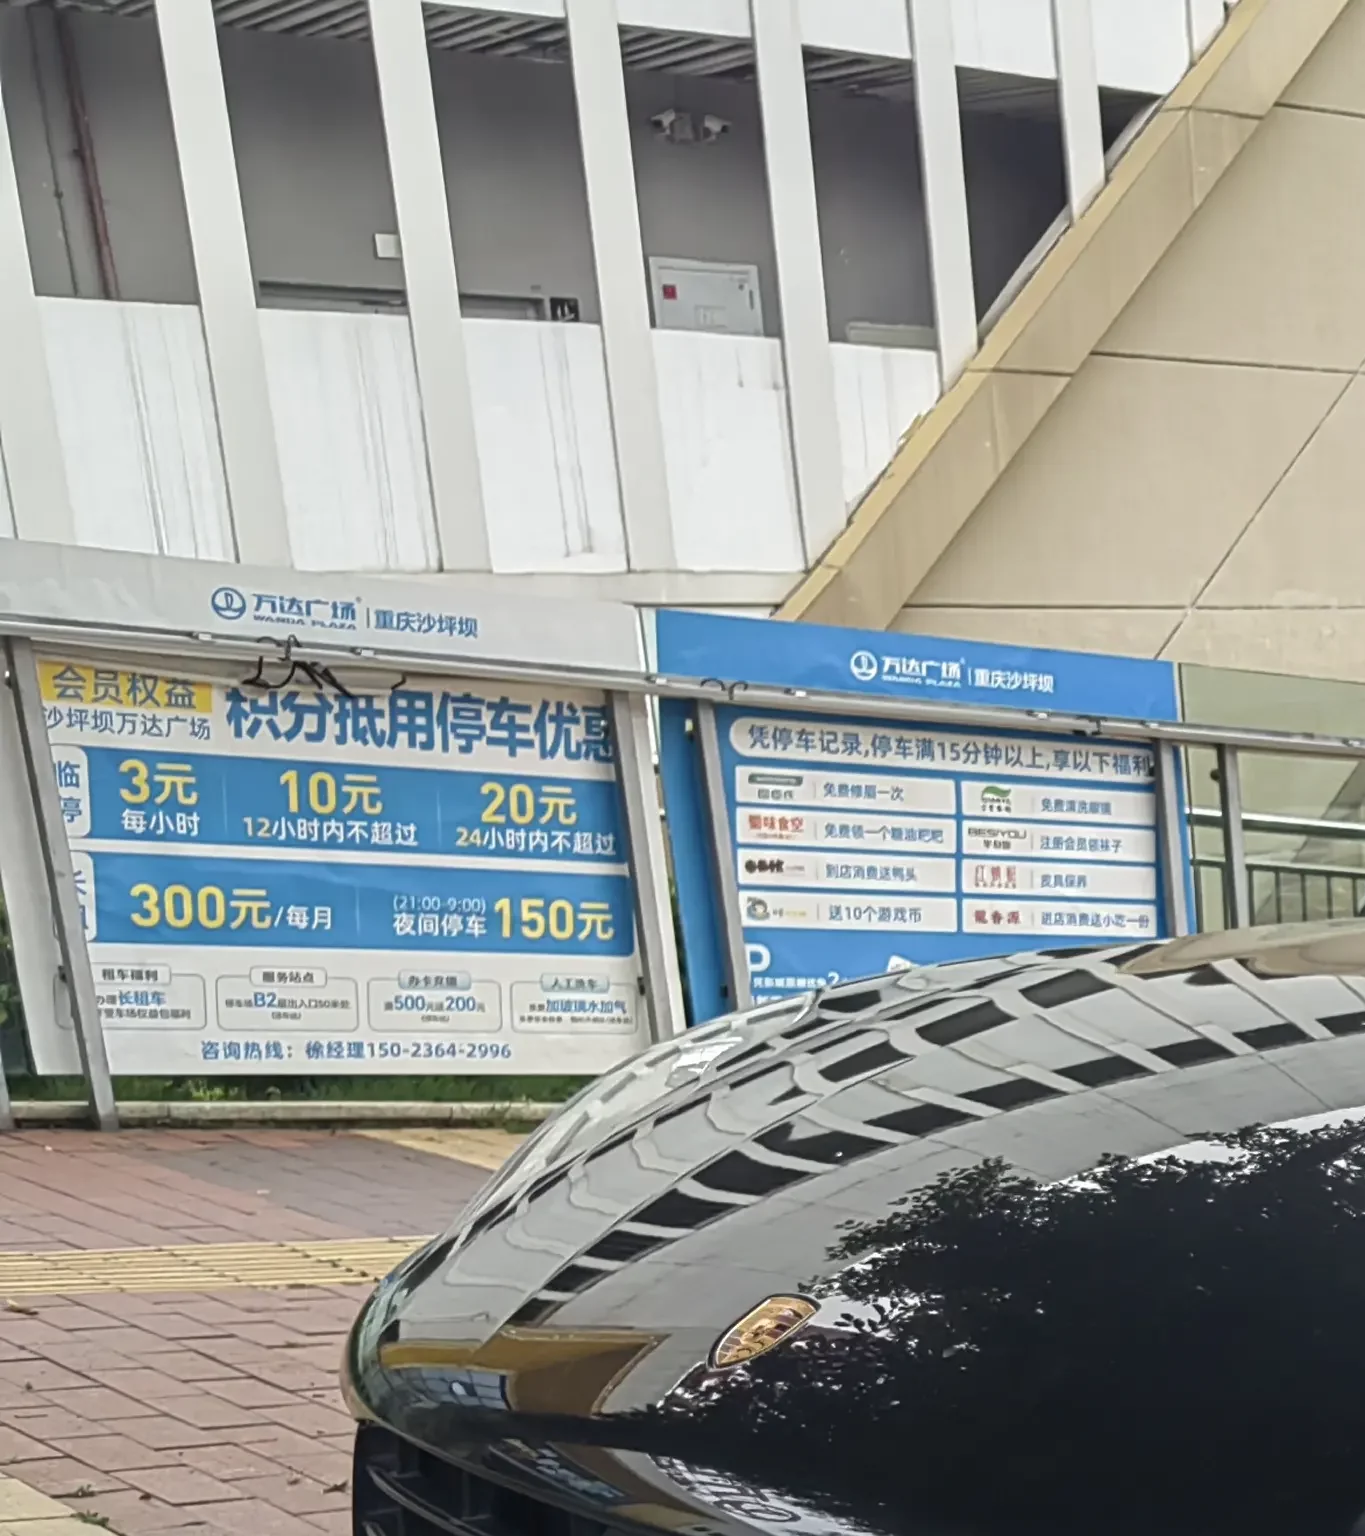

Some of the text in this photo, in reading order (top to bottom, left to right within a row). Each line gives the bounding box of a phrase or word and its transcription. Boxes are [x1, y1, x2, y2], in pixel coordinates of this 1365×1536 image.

[251, 592, 479, 638] 万达广场 重庆沙坪坝
[53, 664, 197, 710] 会员权益
[881, 655, 1054, 693] 万达广场 重庆沙坪坝
[45, 706, 211, 741] 沙坪坝万达广场
[226, 687, 612, 764] 积分抵用停车优惠
[118, 758, 198, 806] 3元
[279, 769, 383, 815] 10元
[480, 781, 577, 826] 20元
[120, 808, 200, 837] 每小时
[243, 816, 418, 847] 12小时内不超过
[456, 826, 616, 855] 24小时内不超过
[392, 912, 488, 939] 夜间停车
[494, 897, 615, 941] 150元
